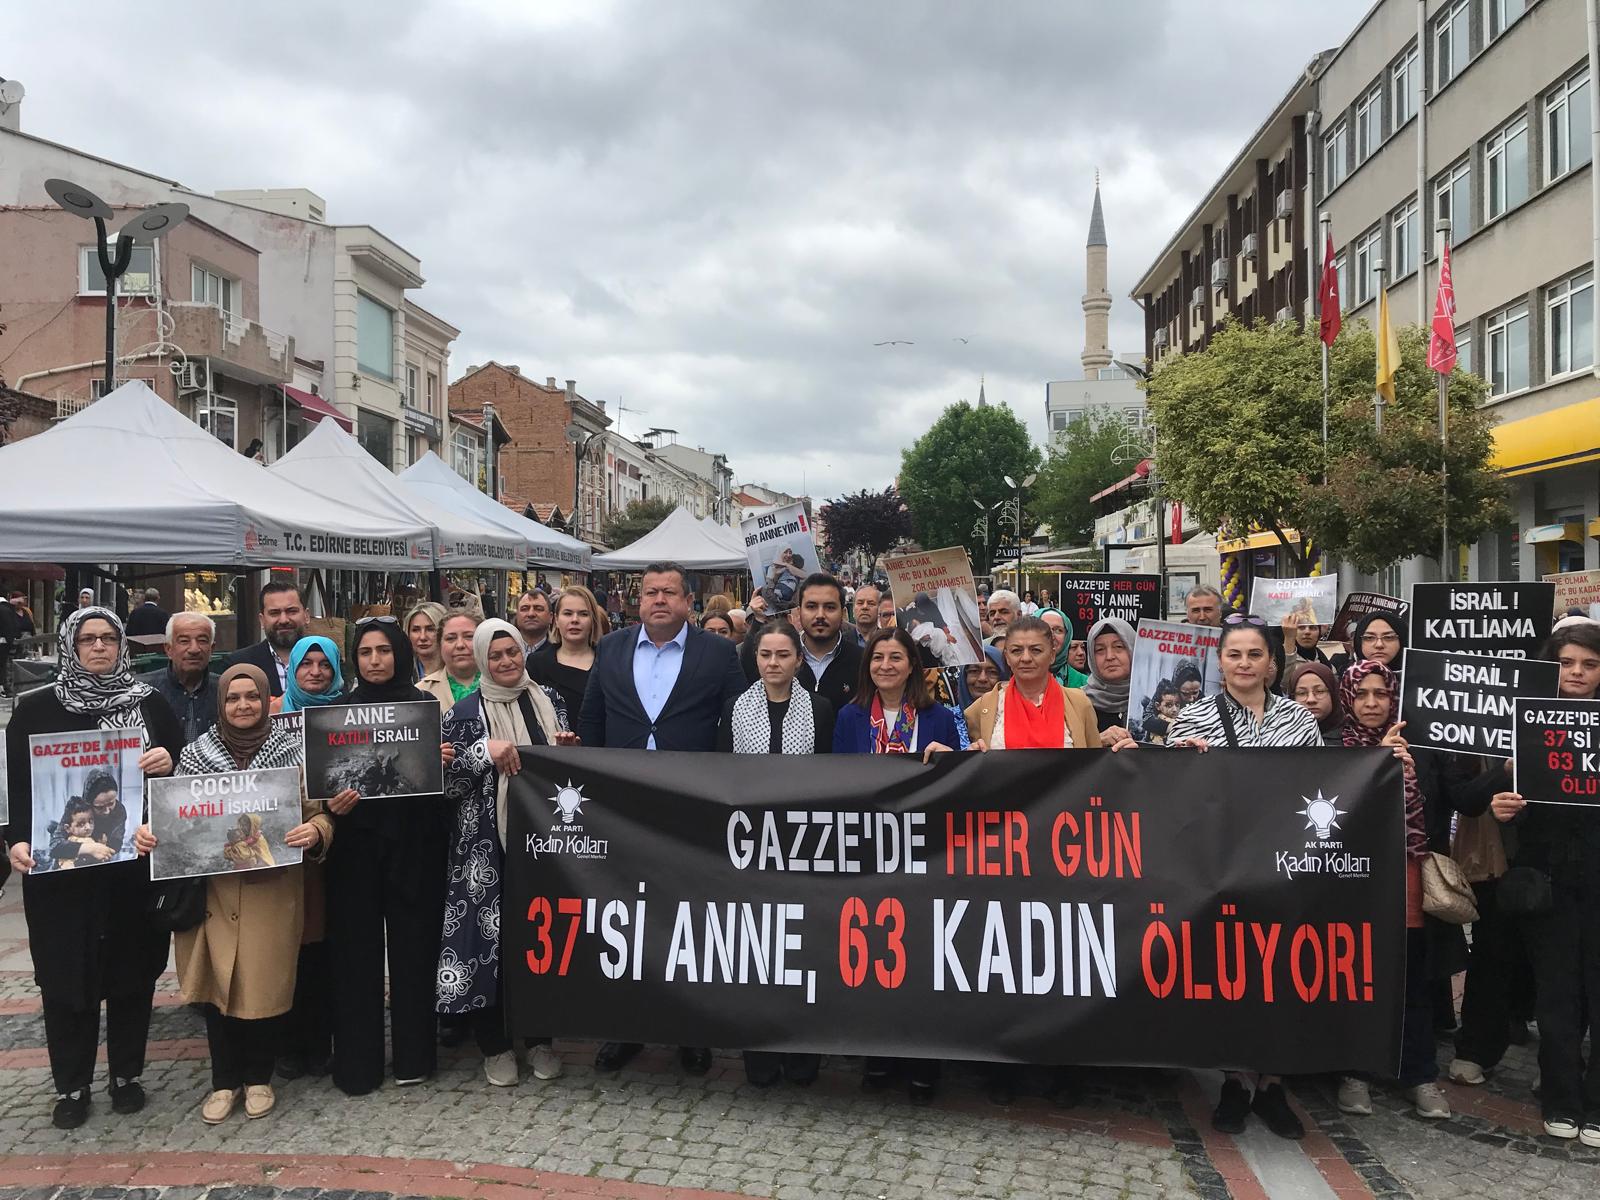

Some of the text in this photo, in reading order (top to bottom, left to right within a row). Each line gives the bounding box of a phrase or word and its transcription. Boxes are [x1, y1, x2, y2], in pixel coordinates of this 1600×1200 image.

[757, 514, 776, 528] BEN
[284, 532, 306, 551] T.C.
[310, 532, 351, 554] EDİRNE
[353, 537, 408, 557] BELEDİYESİ
[745, 532, 759, 547] BİR
[886, 556, 932, 571] ANNE OLMAK
[912, 570, 922, 579] BU
[923, 566, 947, 578] KADAR
[912, 581, 926, 593] ZOR
[1065, 580, 1110, 591] GAZZE'DE
[1113, 581, 1132, 591] HER
[1565, 575, 1589, 585] OLMAK
[1077, 592, 1143, 609] 37'Sİ ANNE,
[1371, 597, 1398, 610] ANNENİN
[1450, 588, 1519, 610] İSRAİL !
[1565, 598, 1579, 606] ZOR
[1079, 608, 1137, 621] 63 KADIN
[1399, 602, 1409, 619] ?
[1425, 615, 1536, 639] KATLİAMA
[1138, 627, 1219, 648] GAZZE'DE ANN
[1158, 643, 1197, 657] OLMAK
[1444, 659, 1519, 688] İSRAİL !
[1416, 687, 1514, 717] KATLİAM
[344, 706, 395, 726] ANNE
[1524, 710, 1599, 726] GAZZE'DE
[327, 726, 420, 746] KATİLİ İSRAİL!
[1429, 721, 1514, 750] SON VE
[1543, 728, 1591, 748] 37'Sİ
[33, 737, 141, 757] GAZZE'DE ANNE
[61, 753, 109, 768] OLMAK
[1548, 751, 1600, 772] 63 K
[190, 774, 258, 801] ÇOCUK
[1561, 774, 1600, 795] ÖLÜ
[178, 796, 278, 819] KATİLİ İSRAİL!
[526, 833, 609, 860] Kadın Kolları
[727, 796, 1142, 879] GAZZE'DE HER GÜN
[1305, 841, 1317, 849] AK
[1275, 851, 1370, 881] Kadın Kolları
[527, 881, 1374, 1004] 37'Sİ ANNE, 63 KADIN ÖLÜYOR!
